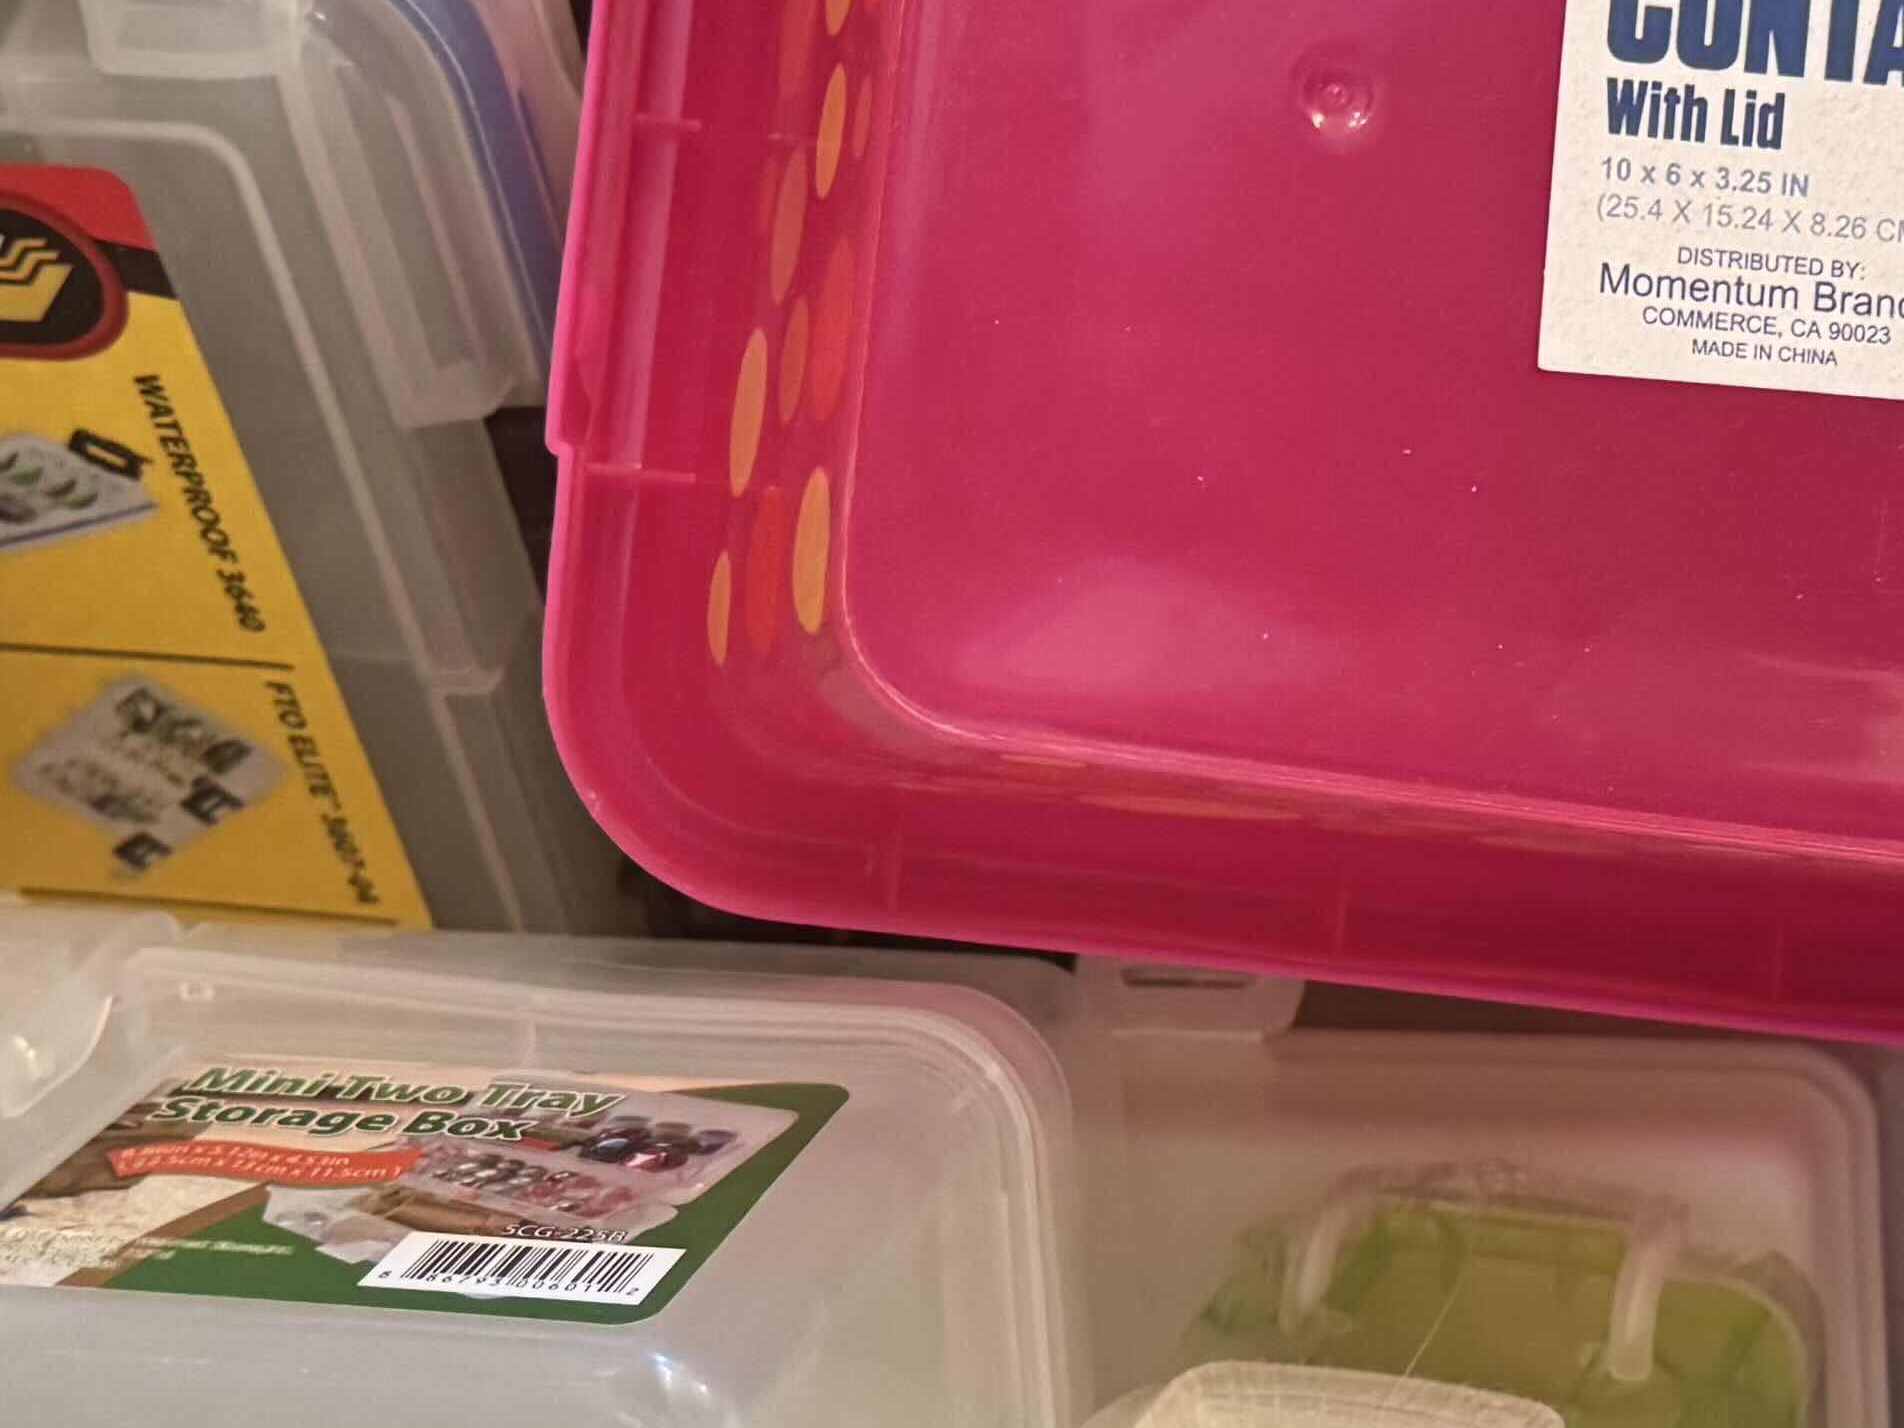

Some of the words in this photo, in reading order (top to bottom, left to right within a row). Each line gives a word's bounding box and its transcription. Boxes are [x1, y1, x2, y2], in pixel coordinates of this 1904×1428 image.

[1606, 77, 1709, 143] With
[1720, 89, 1786, 150] Lid
[1603, 156, 1631, 181] 10
[1642, 164, 1655, 184] x
[1665, 162, 1682, 186] 6
[1691, 168, 1705, 188] x
[1716, 167, 1772, 194] 3.25
[1782, 173, 1810, 197] IN
[1596, 192, 1664, 222] (25.4
[1673, 200, 1693, 223] X
[1704, 203, 1774, 232] 15.24
[1782, 209, 1802, 235] X
[1811, 213, 1867, 240] 8.26
[1599, 261, 1798, 311] Momentum
[1677, 246, 1824, 276] DISTRIBUTED
[1831, 261, 1866, 281] BY:
[1642, 305, 1783, 338] COMMERCE,
[1790, 319, 1822, 340] CA
[1829, 322, 1892, 345] 90023
[1691, 339, 1747, 359] MADE
[1752, 344, 1773, 361] IN
[1778, 346, 1838, 367] CHINA
[133, 375, 239, 565] WATERPROOF
[216, 569, 266, 633] 3640
[264, 680, 307, 730] FTO
[187, 1066, 331, 1097] Mini
[341, 1075, 465, 1105] Two
[478, 1083, 625, 1117] Tray
[150, 1096, 396, 1137] Storage
[400, 1109, 537, 1141] Box
